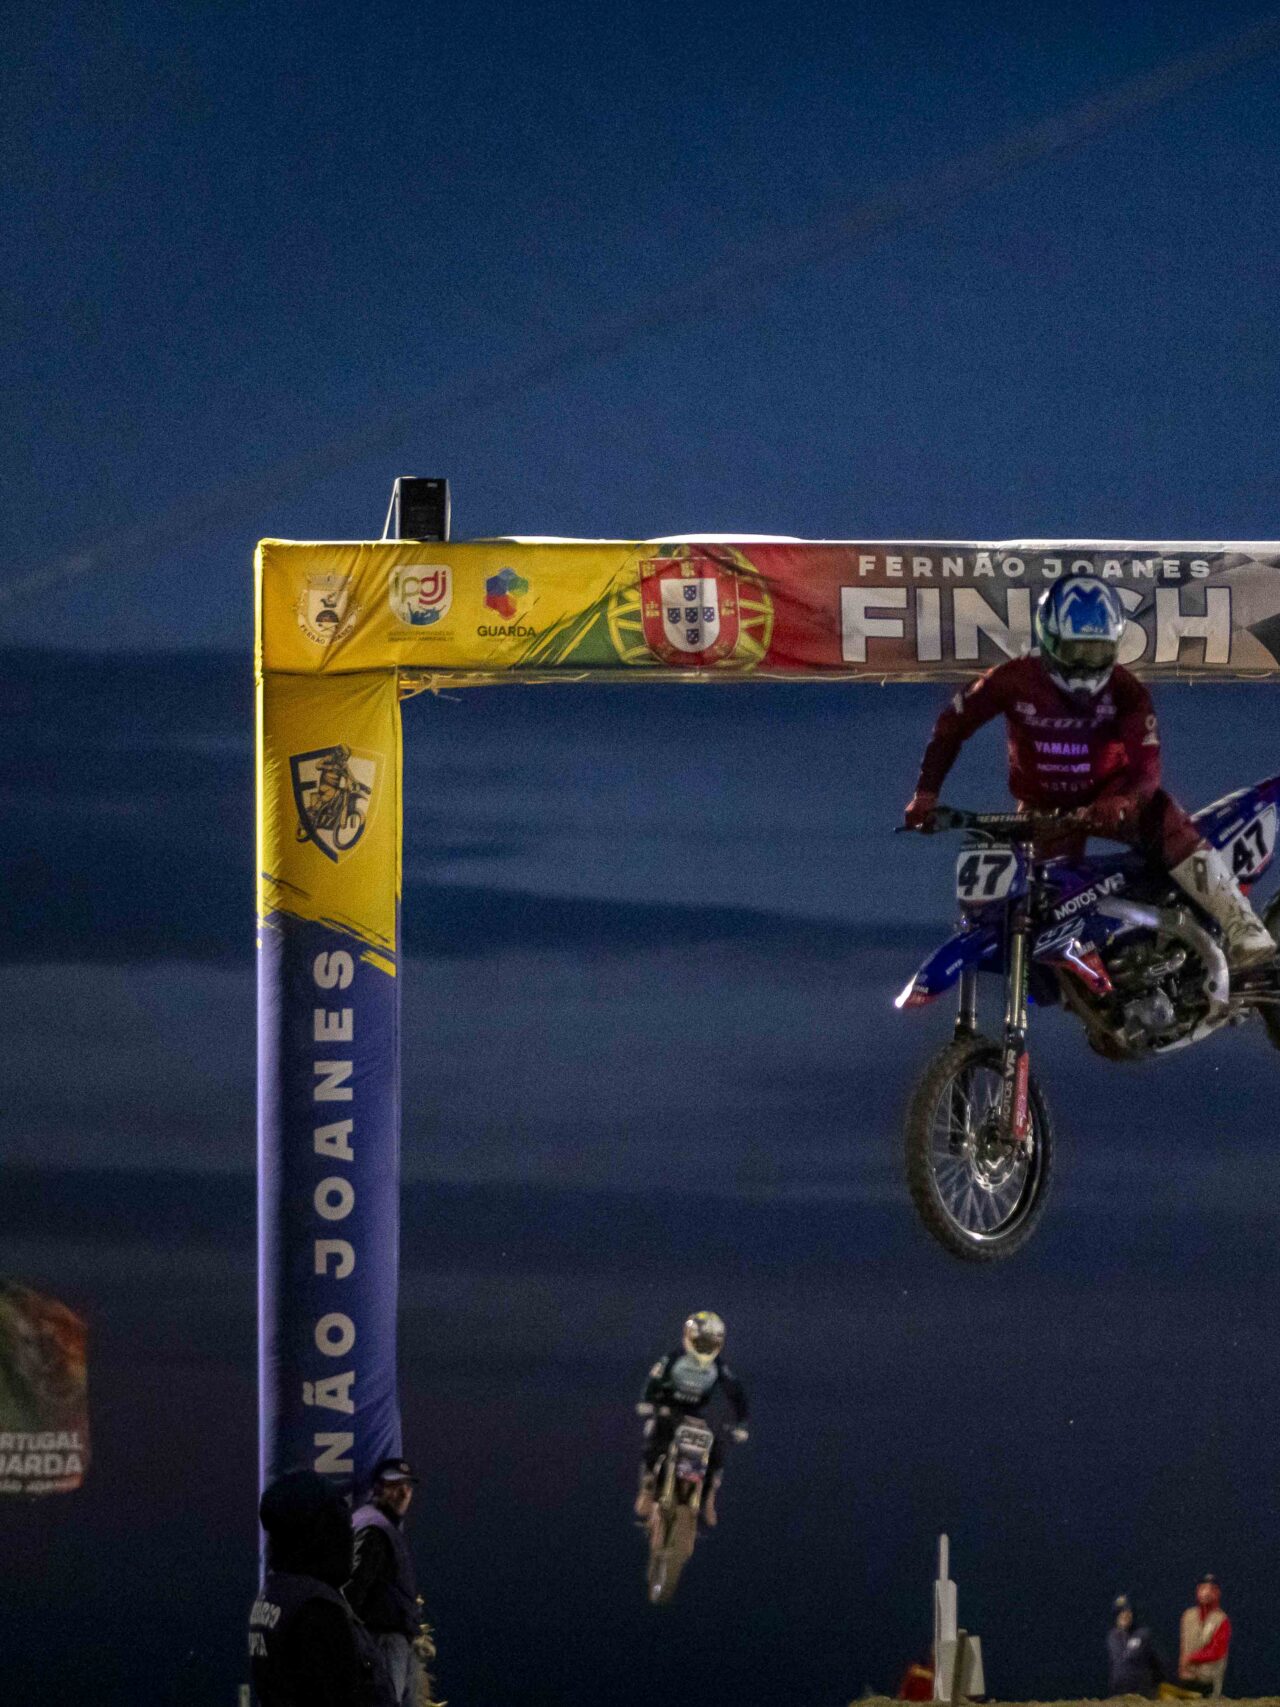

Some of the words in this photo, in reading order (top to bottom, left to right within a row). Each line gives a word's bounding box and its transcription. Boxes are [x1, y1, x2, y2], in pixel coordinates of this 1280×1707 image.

[859, 553, 1025, 578] FERNÃO
[1041, 558, 1211, 579] JOANES
[477, 625, 537, 638] GUARDA
[840, 586, 1232, 664] FINSH
[1034, 740, 1090, 756] YAMAHA
[1232, 820, 1268, 875] 47
[957, 854, 1013, 897] 47
[1054, 888, 1098, 921] MOTOS
[1095, 872, 1126, 897] VR
[312, 949, 356, 1280] JOANES
[302, 1311, 357, 1474] NÃO
